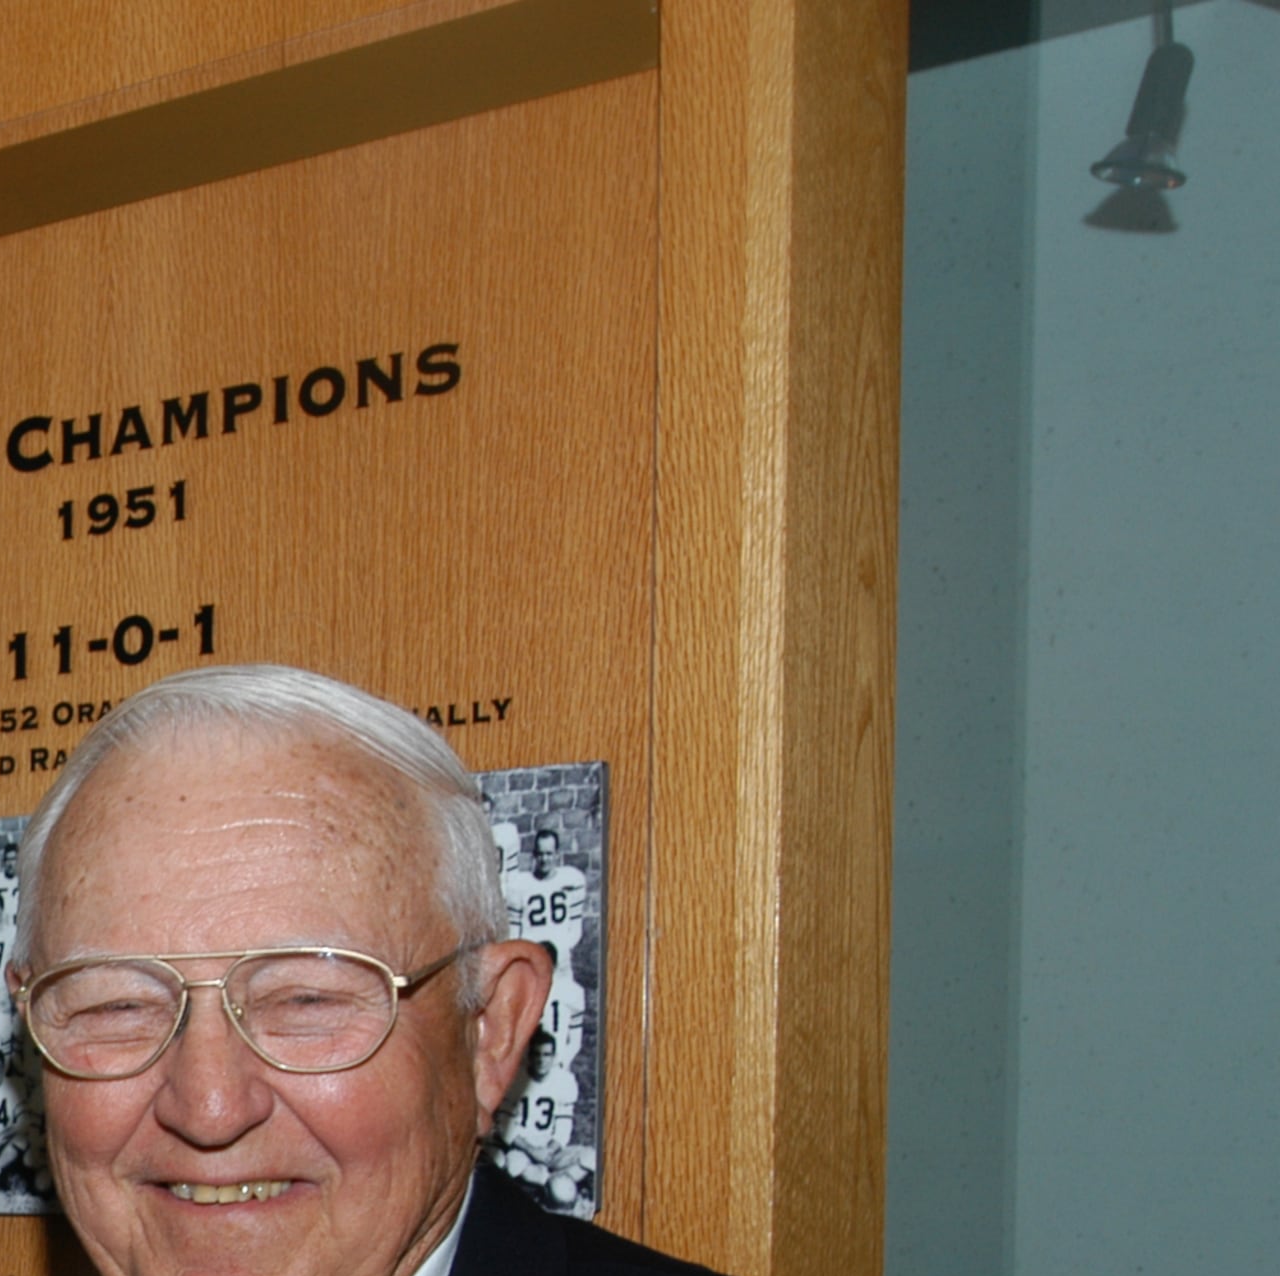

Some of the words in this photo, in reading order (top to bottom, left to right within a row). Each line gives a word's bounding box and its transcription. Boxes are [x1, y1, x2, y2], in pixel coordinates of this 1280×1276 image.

[57, 480, 188, 540] 1951
[7, 604, 217, 680] 11-0-1
[52, 700, 126, 726] ORA
[413, 698, 513, 727] ALLY
[29, 748, 70, 773] RA
[527, 891, 567, 926] 26
[520, 1097, 555, 1131] 13
